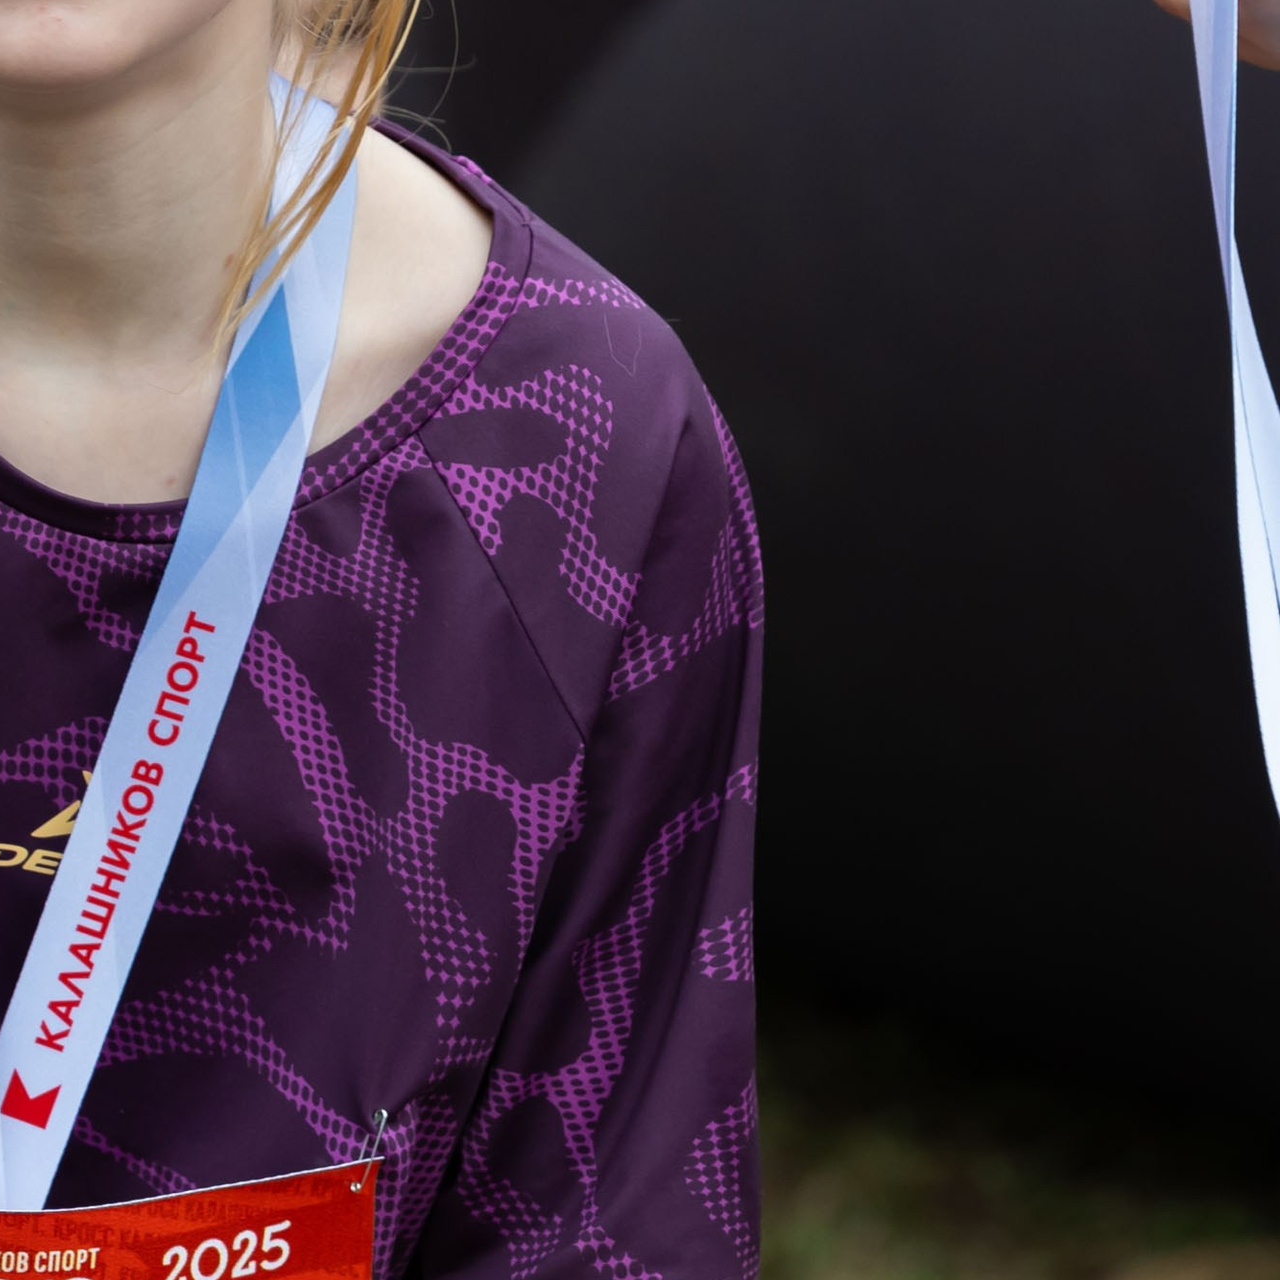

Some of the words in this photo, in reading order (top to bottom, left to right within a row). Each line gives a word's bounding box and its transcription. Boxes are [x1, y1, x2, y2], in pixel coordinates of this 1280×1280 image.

[35, 759, 164, 1053] КАЛАШНИКОВ
[147, 611, 216, 747] СПОРТ
[33, 1247, 100, 1273] СПОРТ
